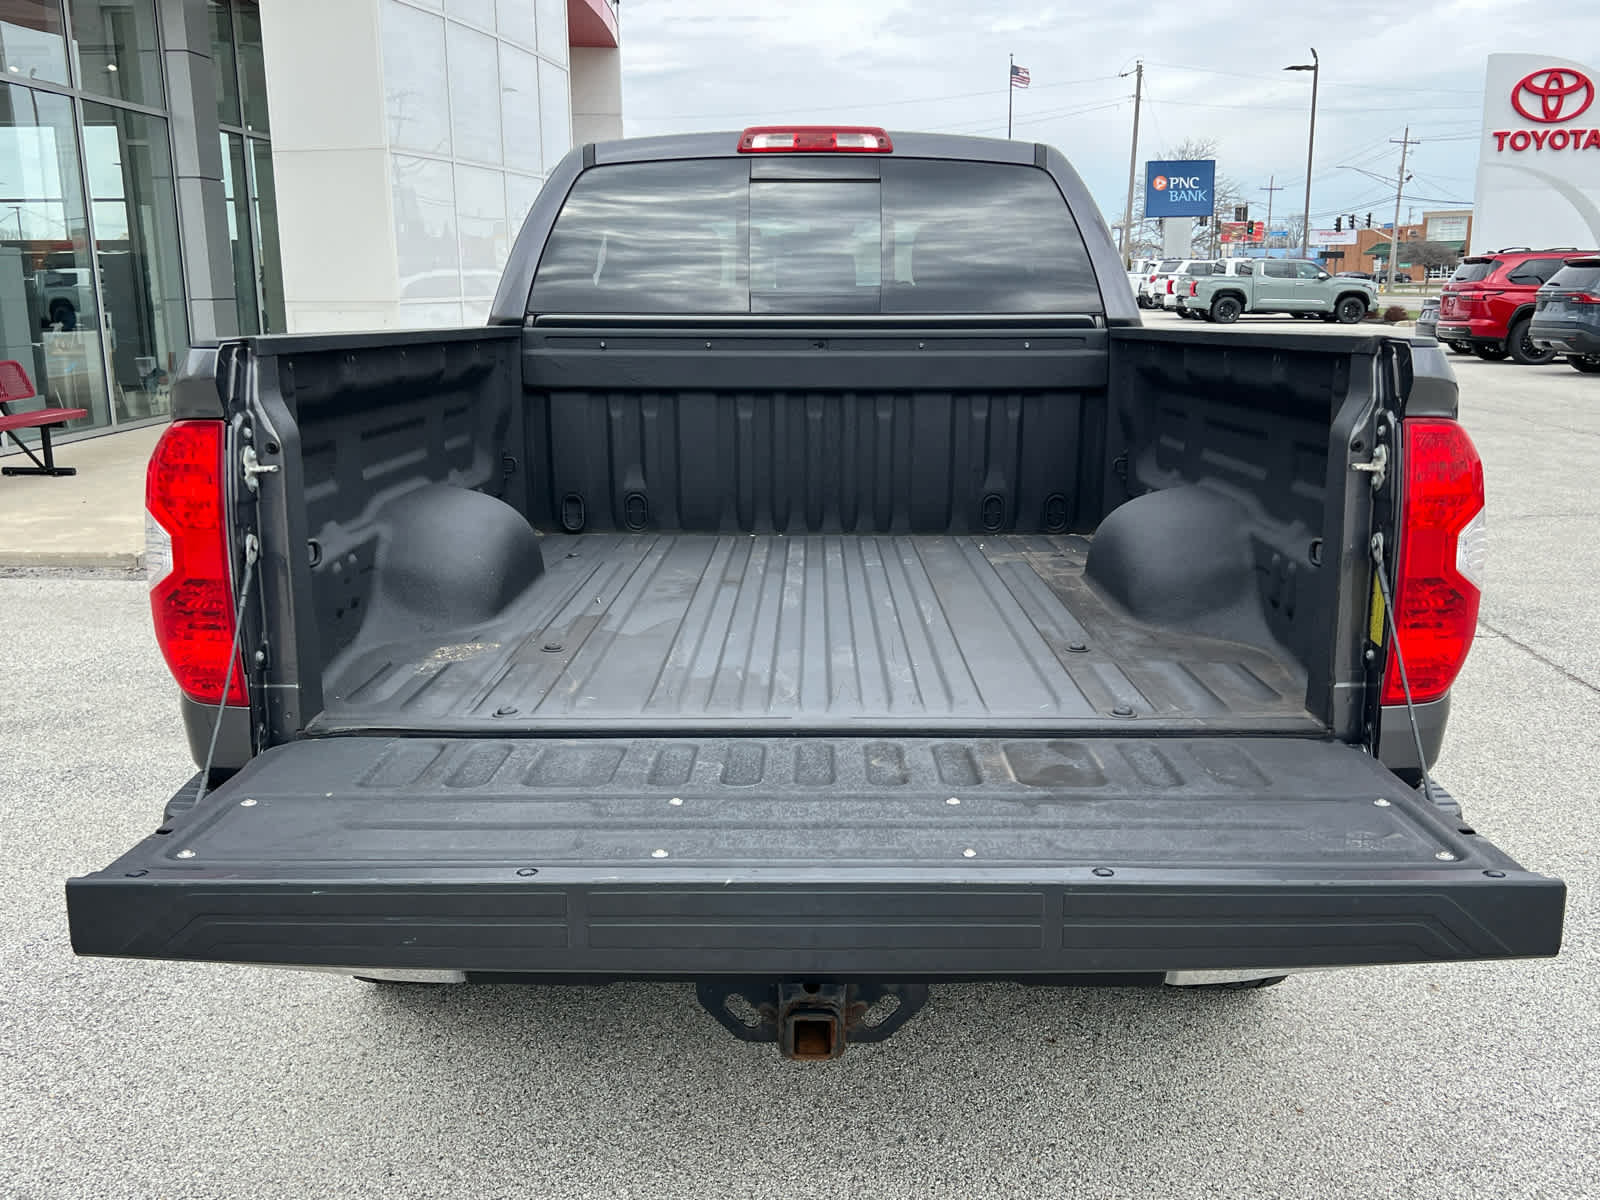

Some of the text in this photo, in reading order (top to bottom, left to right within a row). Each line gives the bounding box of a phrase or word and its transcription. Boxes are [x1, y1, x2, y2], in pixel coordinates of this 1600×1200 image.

[1493, 129, 1600, 152] TOYOTA
[1168, 176, 1200, 189] PNC
[1168, 190, 1208, 202] BANK
